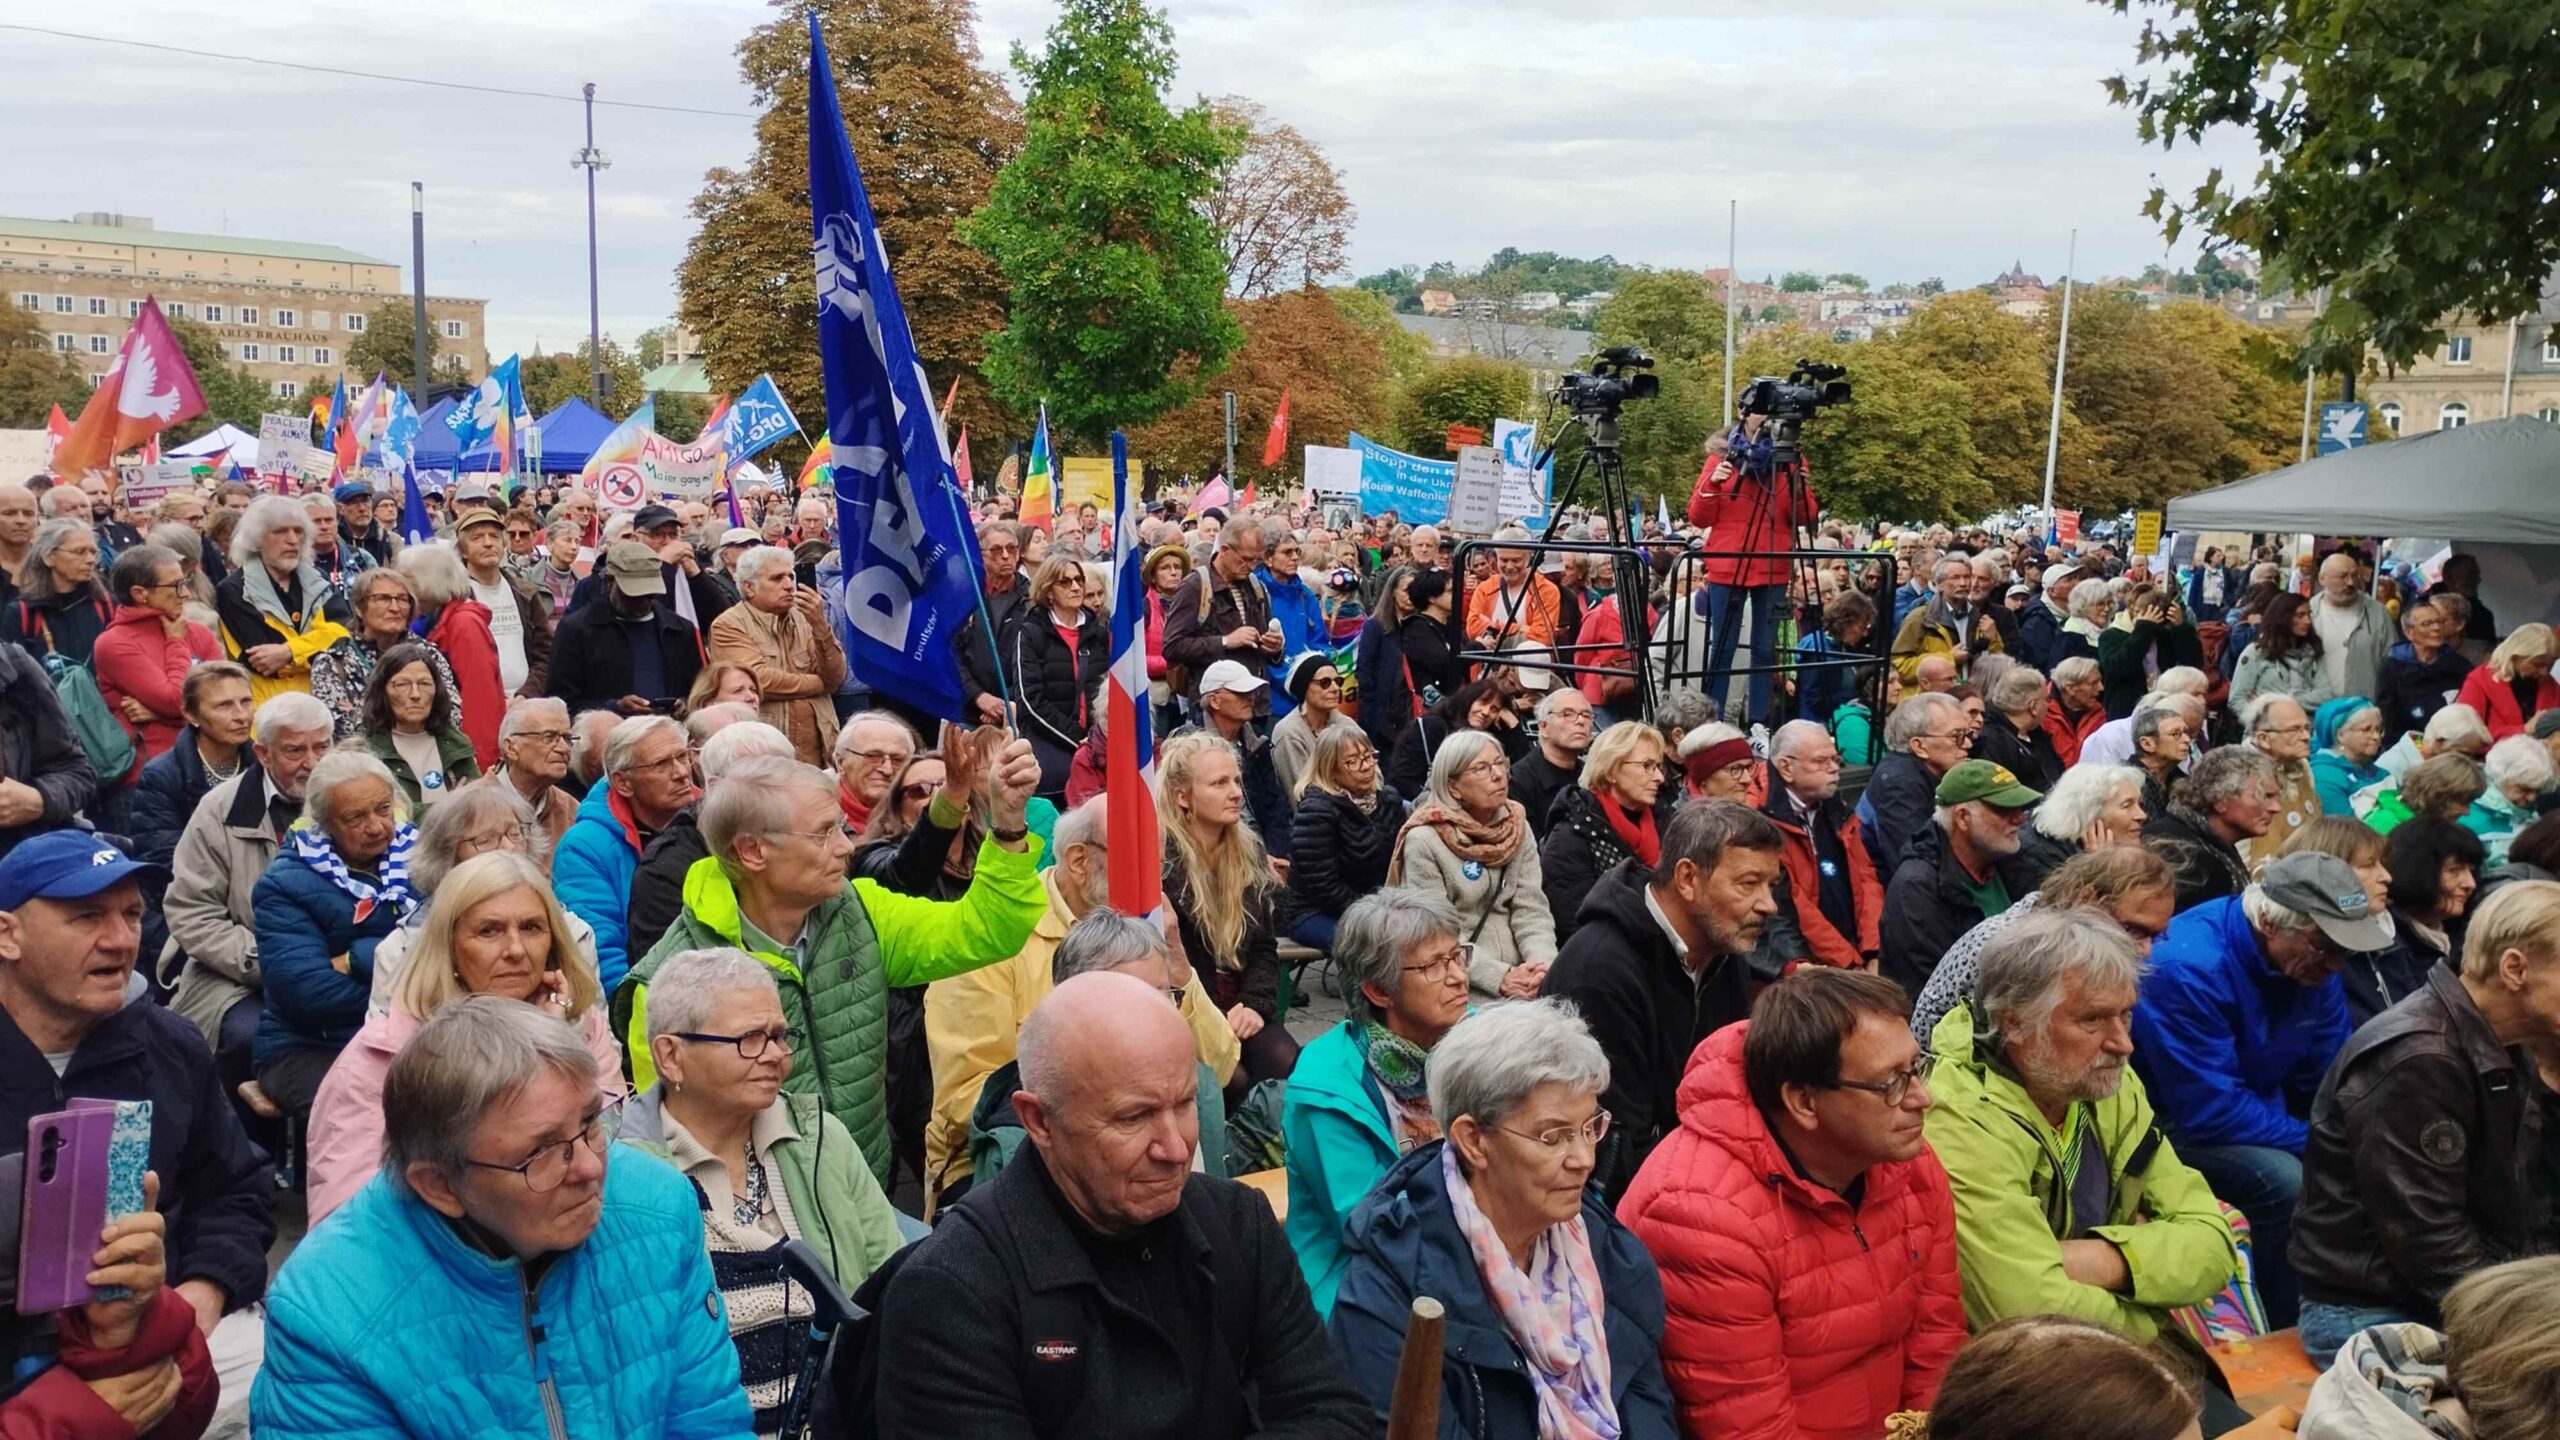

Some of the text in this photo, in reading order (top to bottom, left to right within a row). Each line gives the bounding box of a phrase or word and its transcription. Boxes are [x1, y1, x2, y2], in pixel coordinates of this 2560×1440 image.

[217, 327, 329, 342] ARLS BRAUHAUS
[264, 415, 295, 427] PEACE
[1365, 447, 1407, 469] Stopp
[1411, 463, 1440, 474] den
[1396, 470, 1407, 480] in
[1409, 475, 1428, 484] der
[1361, 477, 1393, 492] Keine
[1036, 1346, 1077, 1354] EASTPAK
